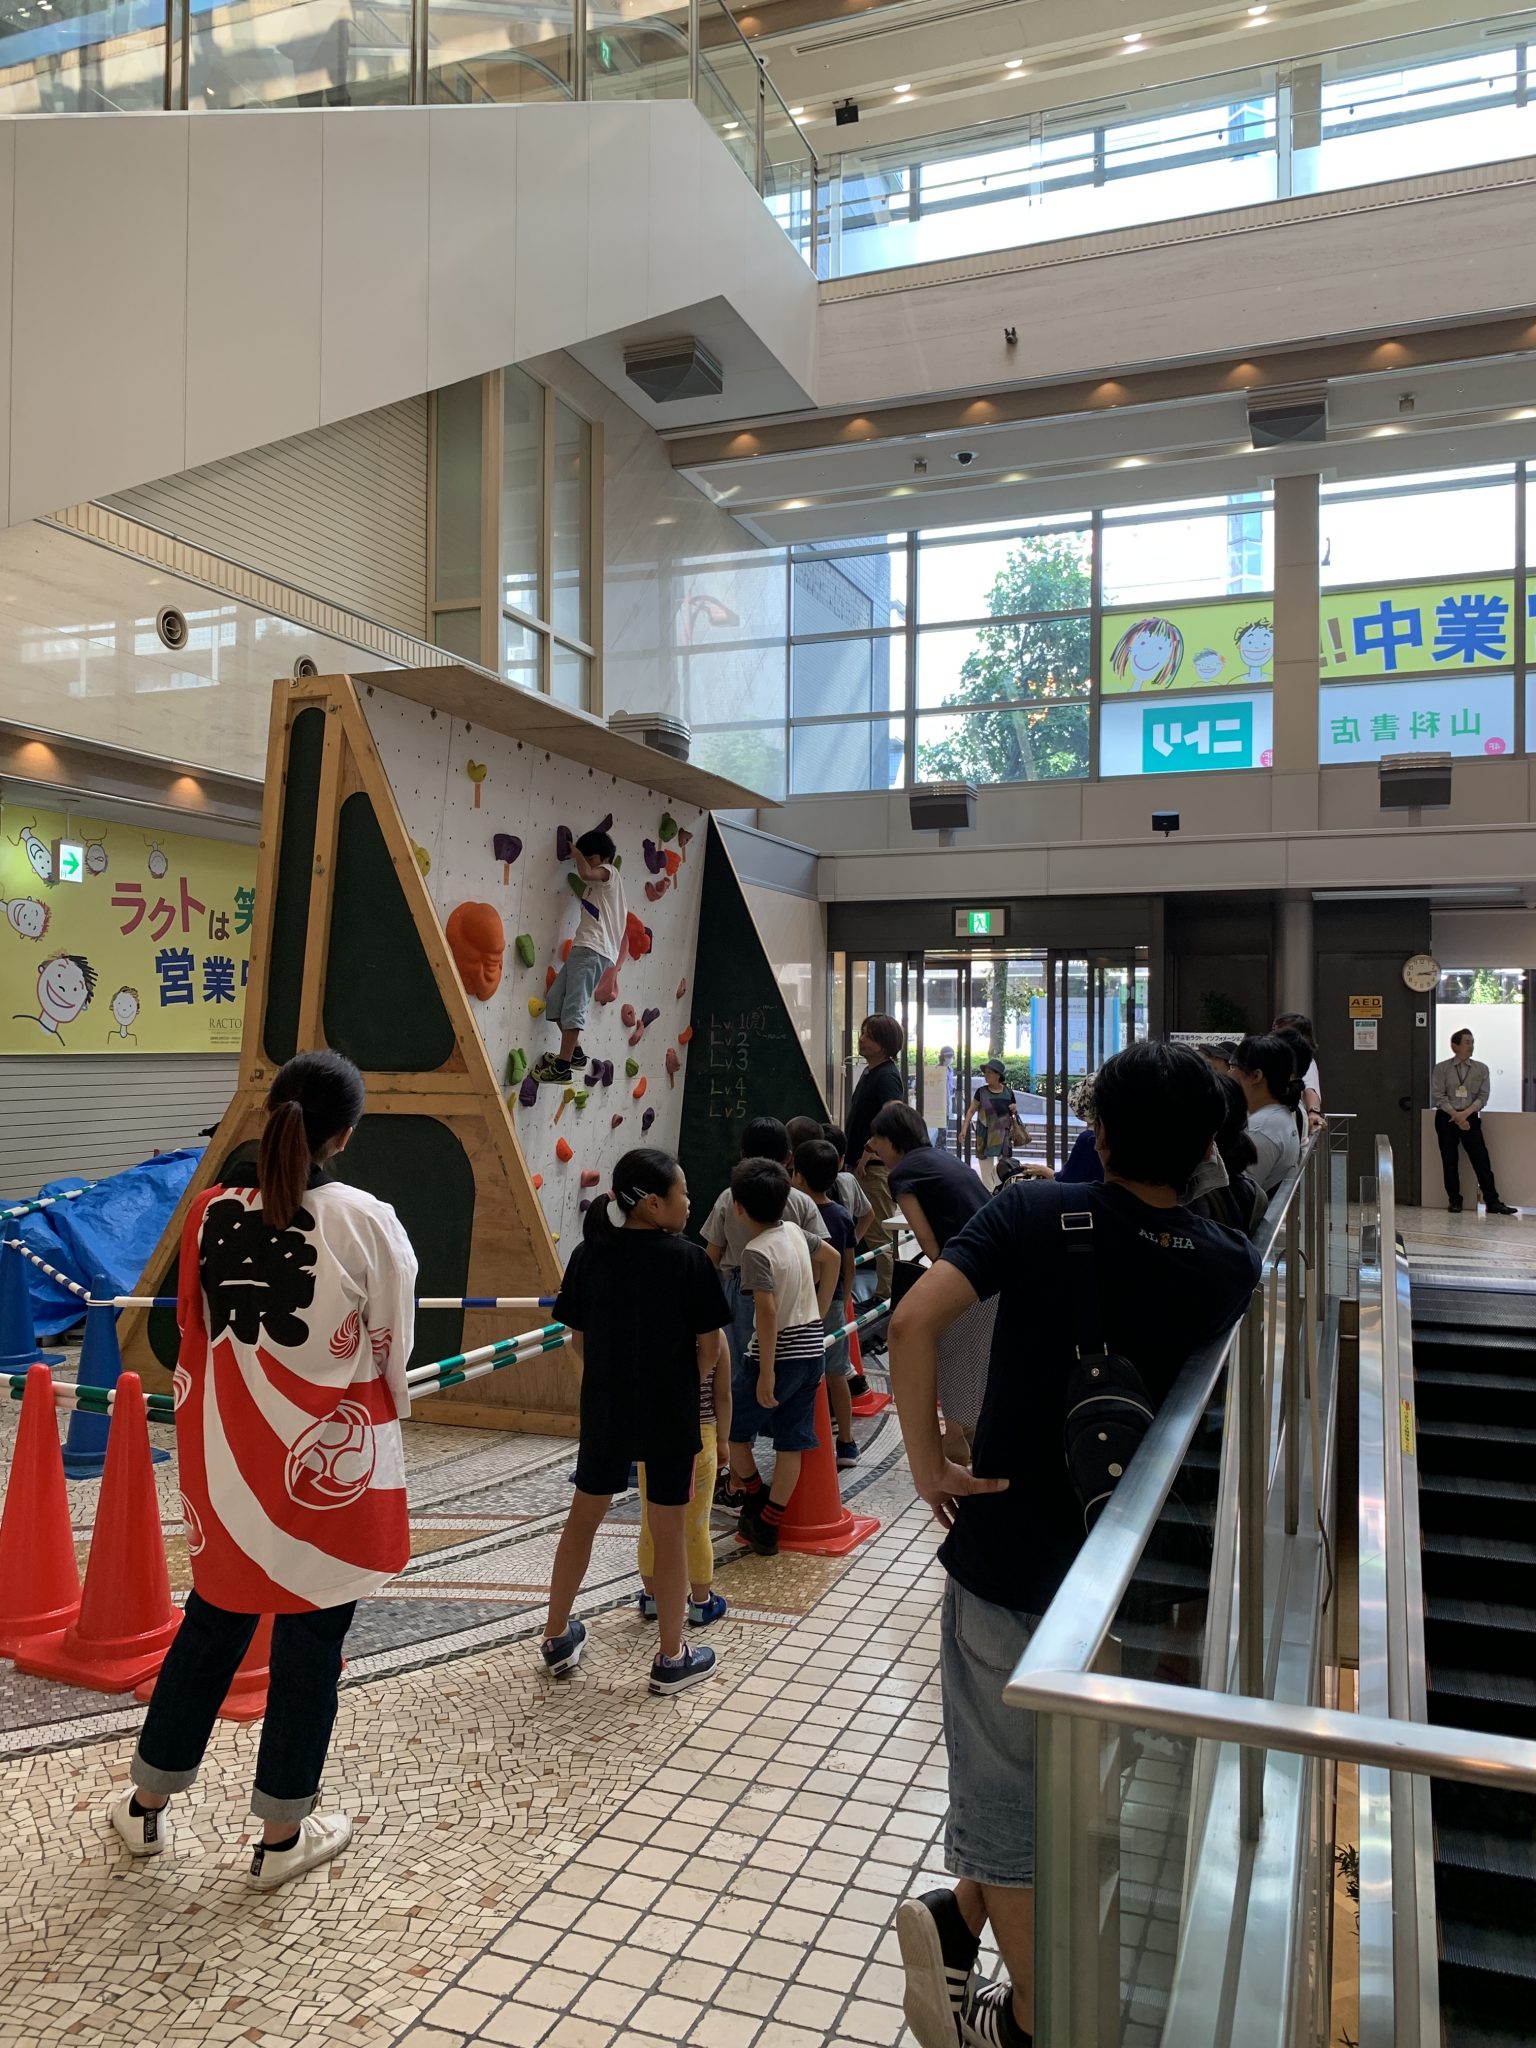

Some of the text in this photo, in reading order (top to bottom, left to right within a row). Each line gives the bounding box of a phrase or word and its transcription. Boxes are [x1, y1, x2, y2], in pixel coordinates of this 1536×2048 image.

[155, 947, 249, 1007] 営業
[1351, 998, 1381, 1006] AED
[209, 1017, 242, 1029] RACTO
[737, 1031, 750, 1047] 2
[736, 1048, 749, 1071] 3
[735, 1077, 747, 1096] 4
[736, 1100, 747, 1119] 5
[199, 1198, 318, 1348] 祭
